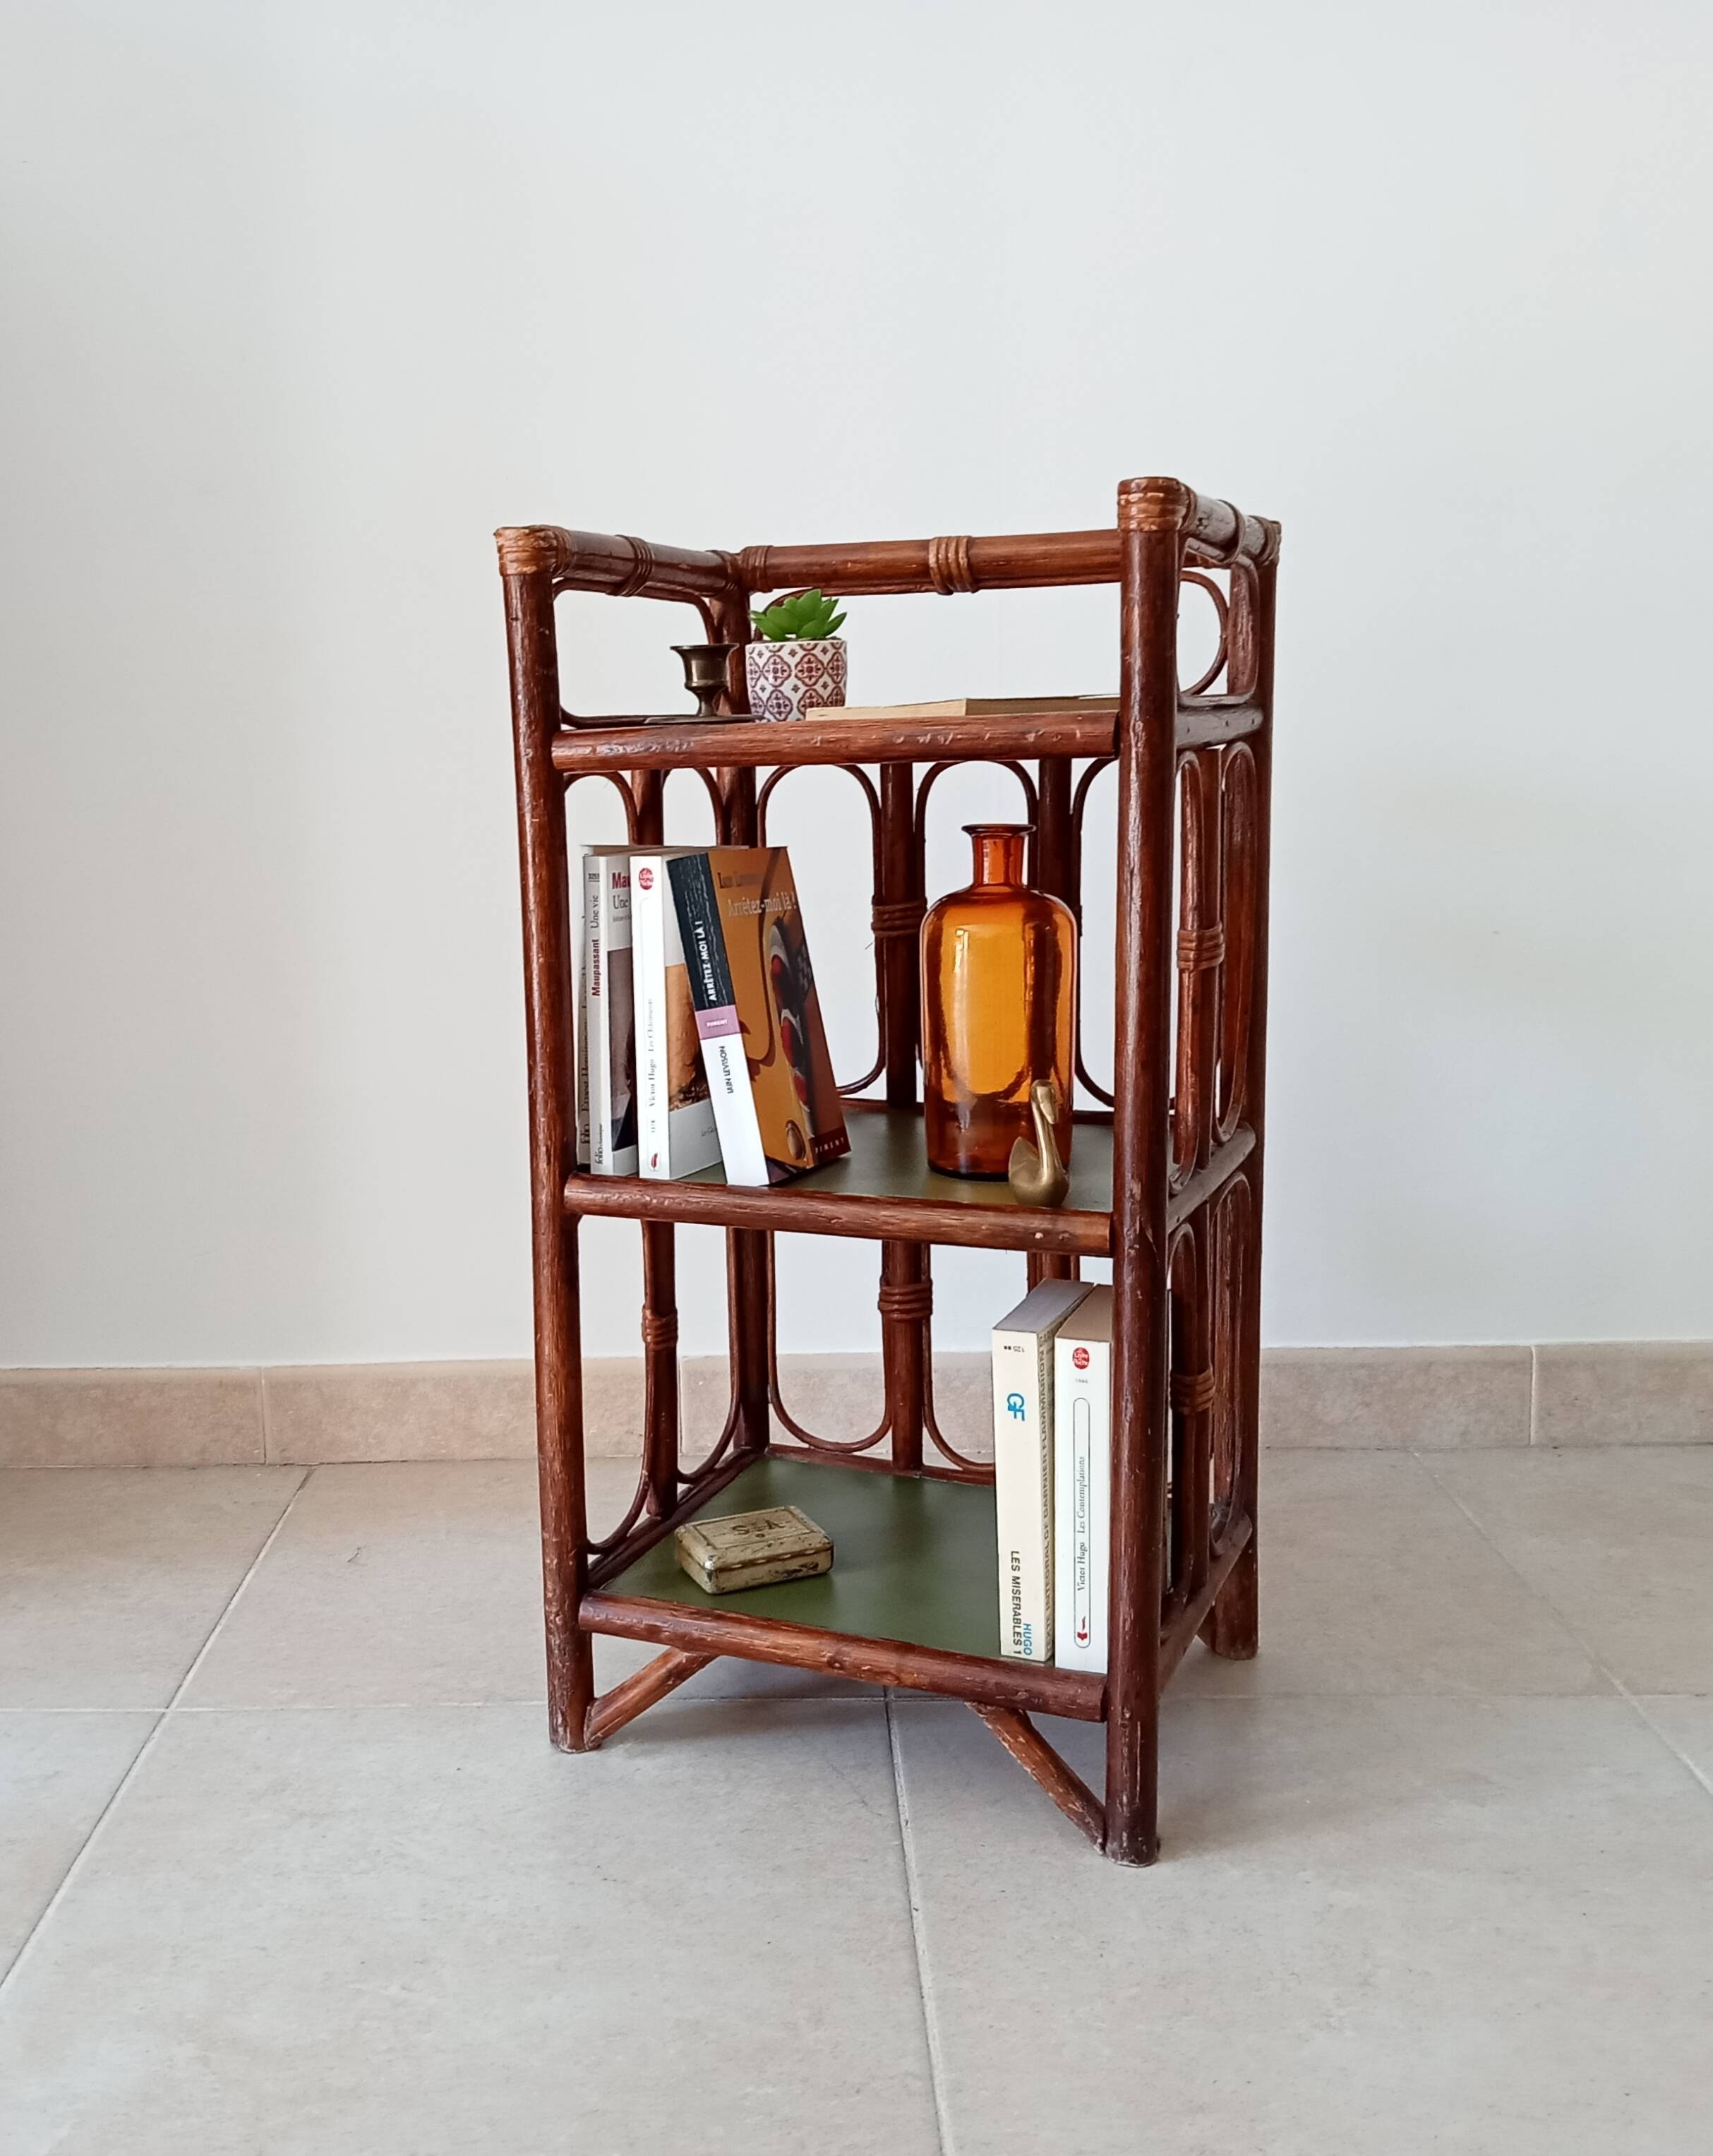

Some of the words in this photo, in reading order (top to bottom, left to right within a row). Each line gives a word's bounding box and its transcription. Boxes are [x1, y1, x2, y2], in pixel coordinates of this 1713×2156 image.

[589, 894, 599, 909] vie
[613, 894, 628, 909] Une
[590, 911, 599, 928] Une
[591, 939, 601, 996] Maupassant
[719, 1046, 731, 1077] LEVISON
[723, 1078, 734, 1094] IAIN
[594, 1147, 603, 1164] folio
[815, 1137, 844, 1154] PIMENT
[1007, 1393, 1025, 1421] GF
[1076, 1456, 1088, 1519] Contemplations
[1011, 1551, 1021, 1571] LES
[1077, 1542, 1088, 1564] Hugo
[1077, 1567, 1086, 1591] Victor
[1011, 1576, 1022, 1646] MISERABLES
[1023, 1623, 1033, 1655] HUGO
